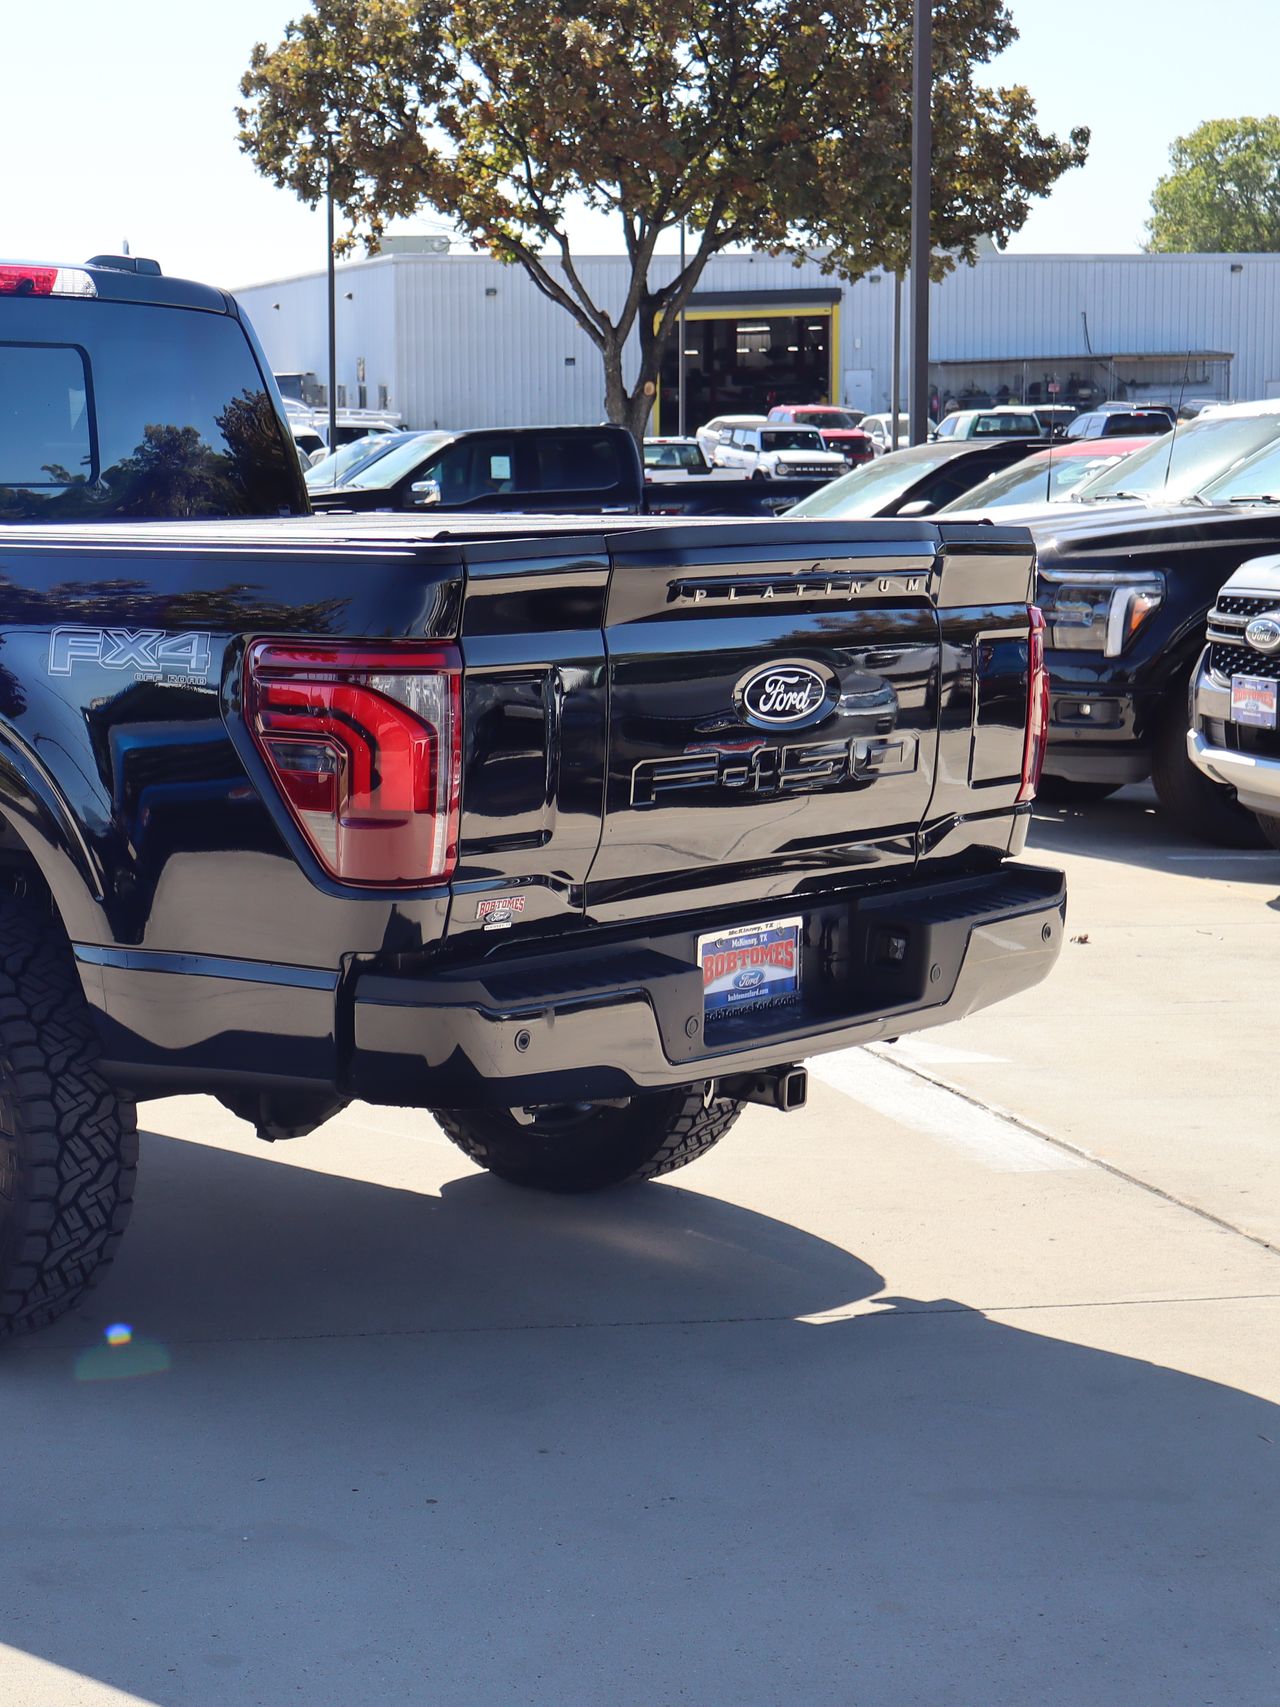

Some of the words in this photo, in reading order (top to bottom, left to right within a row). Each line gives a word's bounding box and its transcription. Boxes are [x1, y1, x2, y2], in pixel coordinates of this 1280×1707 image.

[693, 578, 920, 602] PLATINUM
[47, 624, 212, 677] FX4
[133, 673, 164, 682] OFF
[168, 675, 207, 686] ROAD
[758, 675, 812, 713] Ford
[629, 731, 921, 806] F-150
[728, 926, 763, 936] McKinney,
[759, 934, 768, 943] TX
[738, 972, 761, 988] Ford
